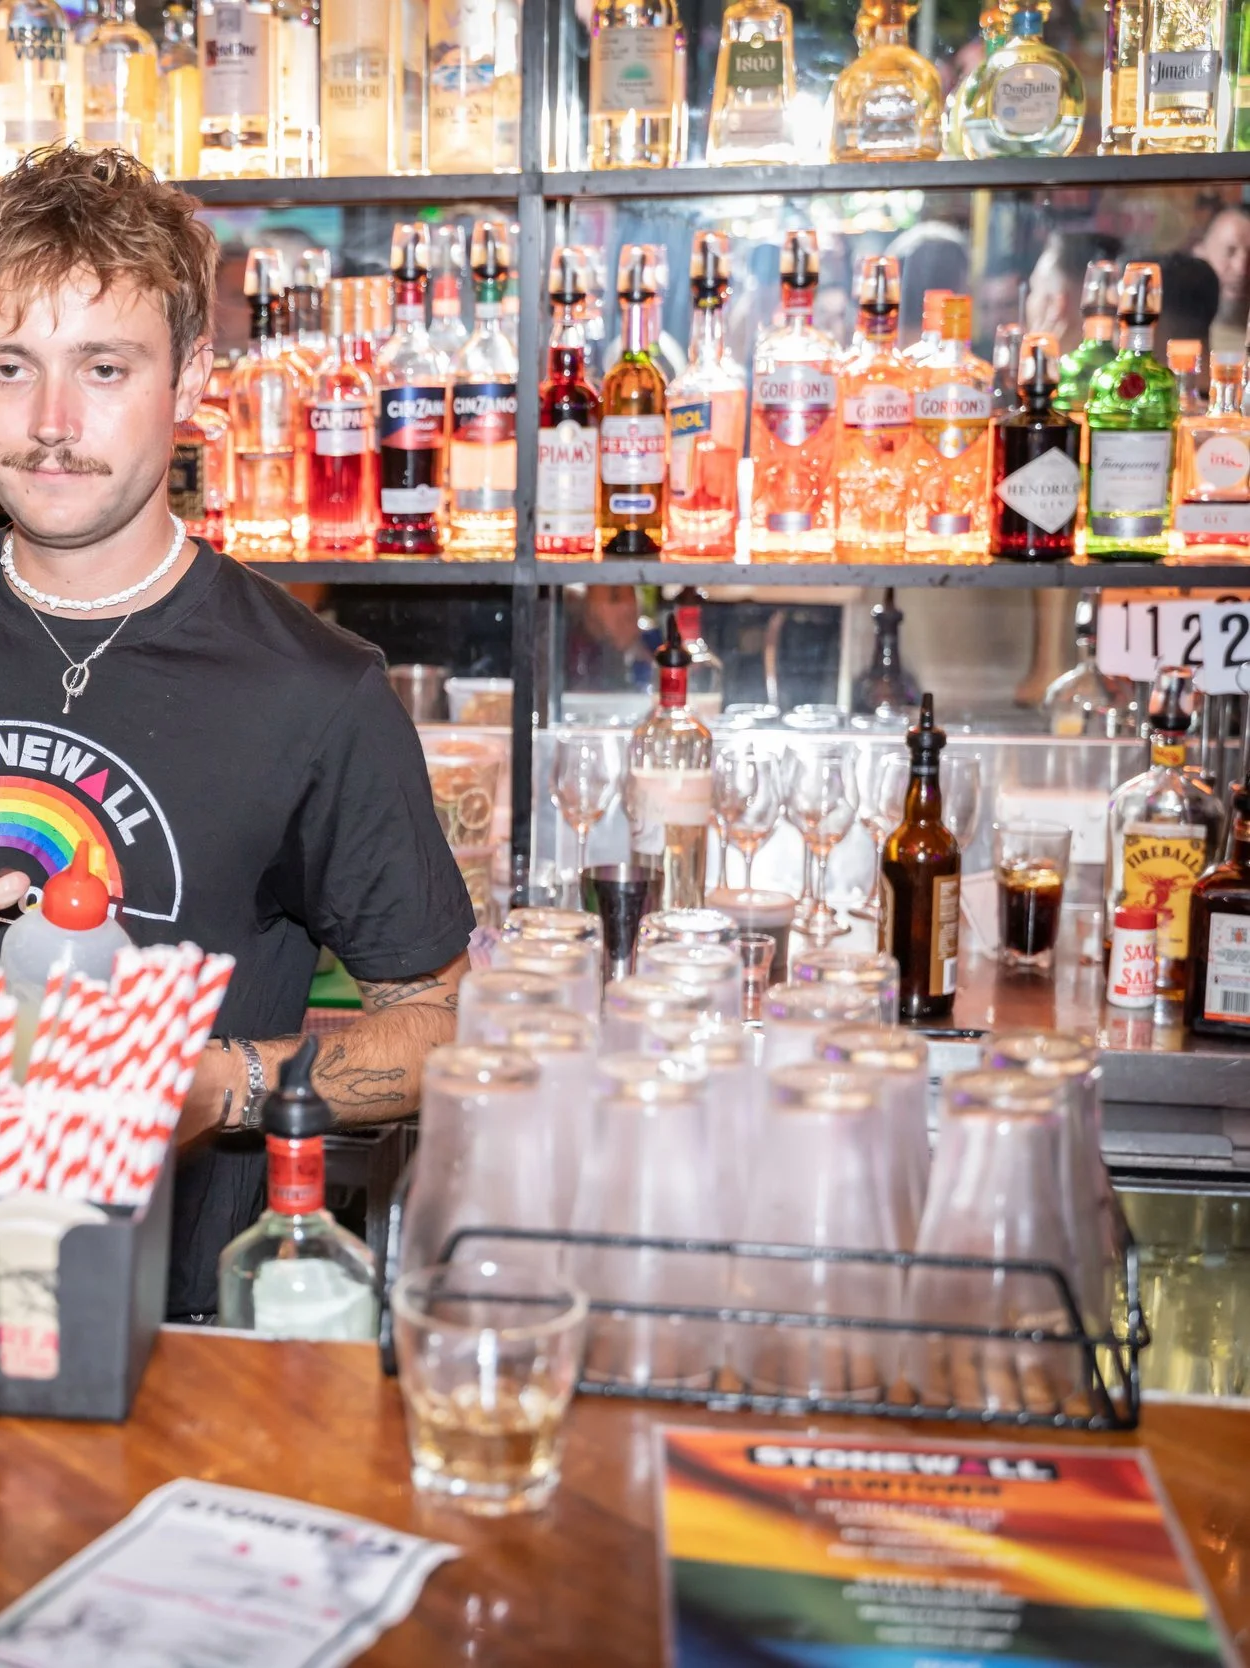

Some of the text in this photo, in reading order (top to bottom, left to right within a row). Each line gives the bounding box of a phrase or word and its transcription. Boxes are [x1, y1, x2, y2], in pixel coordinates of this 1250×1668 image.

[735, 55, 777, 73] 1800
[387, 397, 445, 419] CINZAN
[453, 395, 518, 415] CINZANO
[856, 404, 909, 420] GORDON
[539, 441, 594, 464] PIMM'S
[1126, 845, 1202, 878] FIREBALL
[1123, 943, 1156, 962] SAX
[1121, 967, 1155, 985] SAL
[752, 1444, 1058, 1483] STONEWALL
